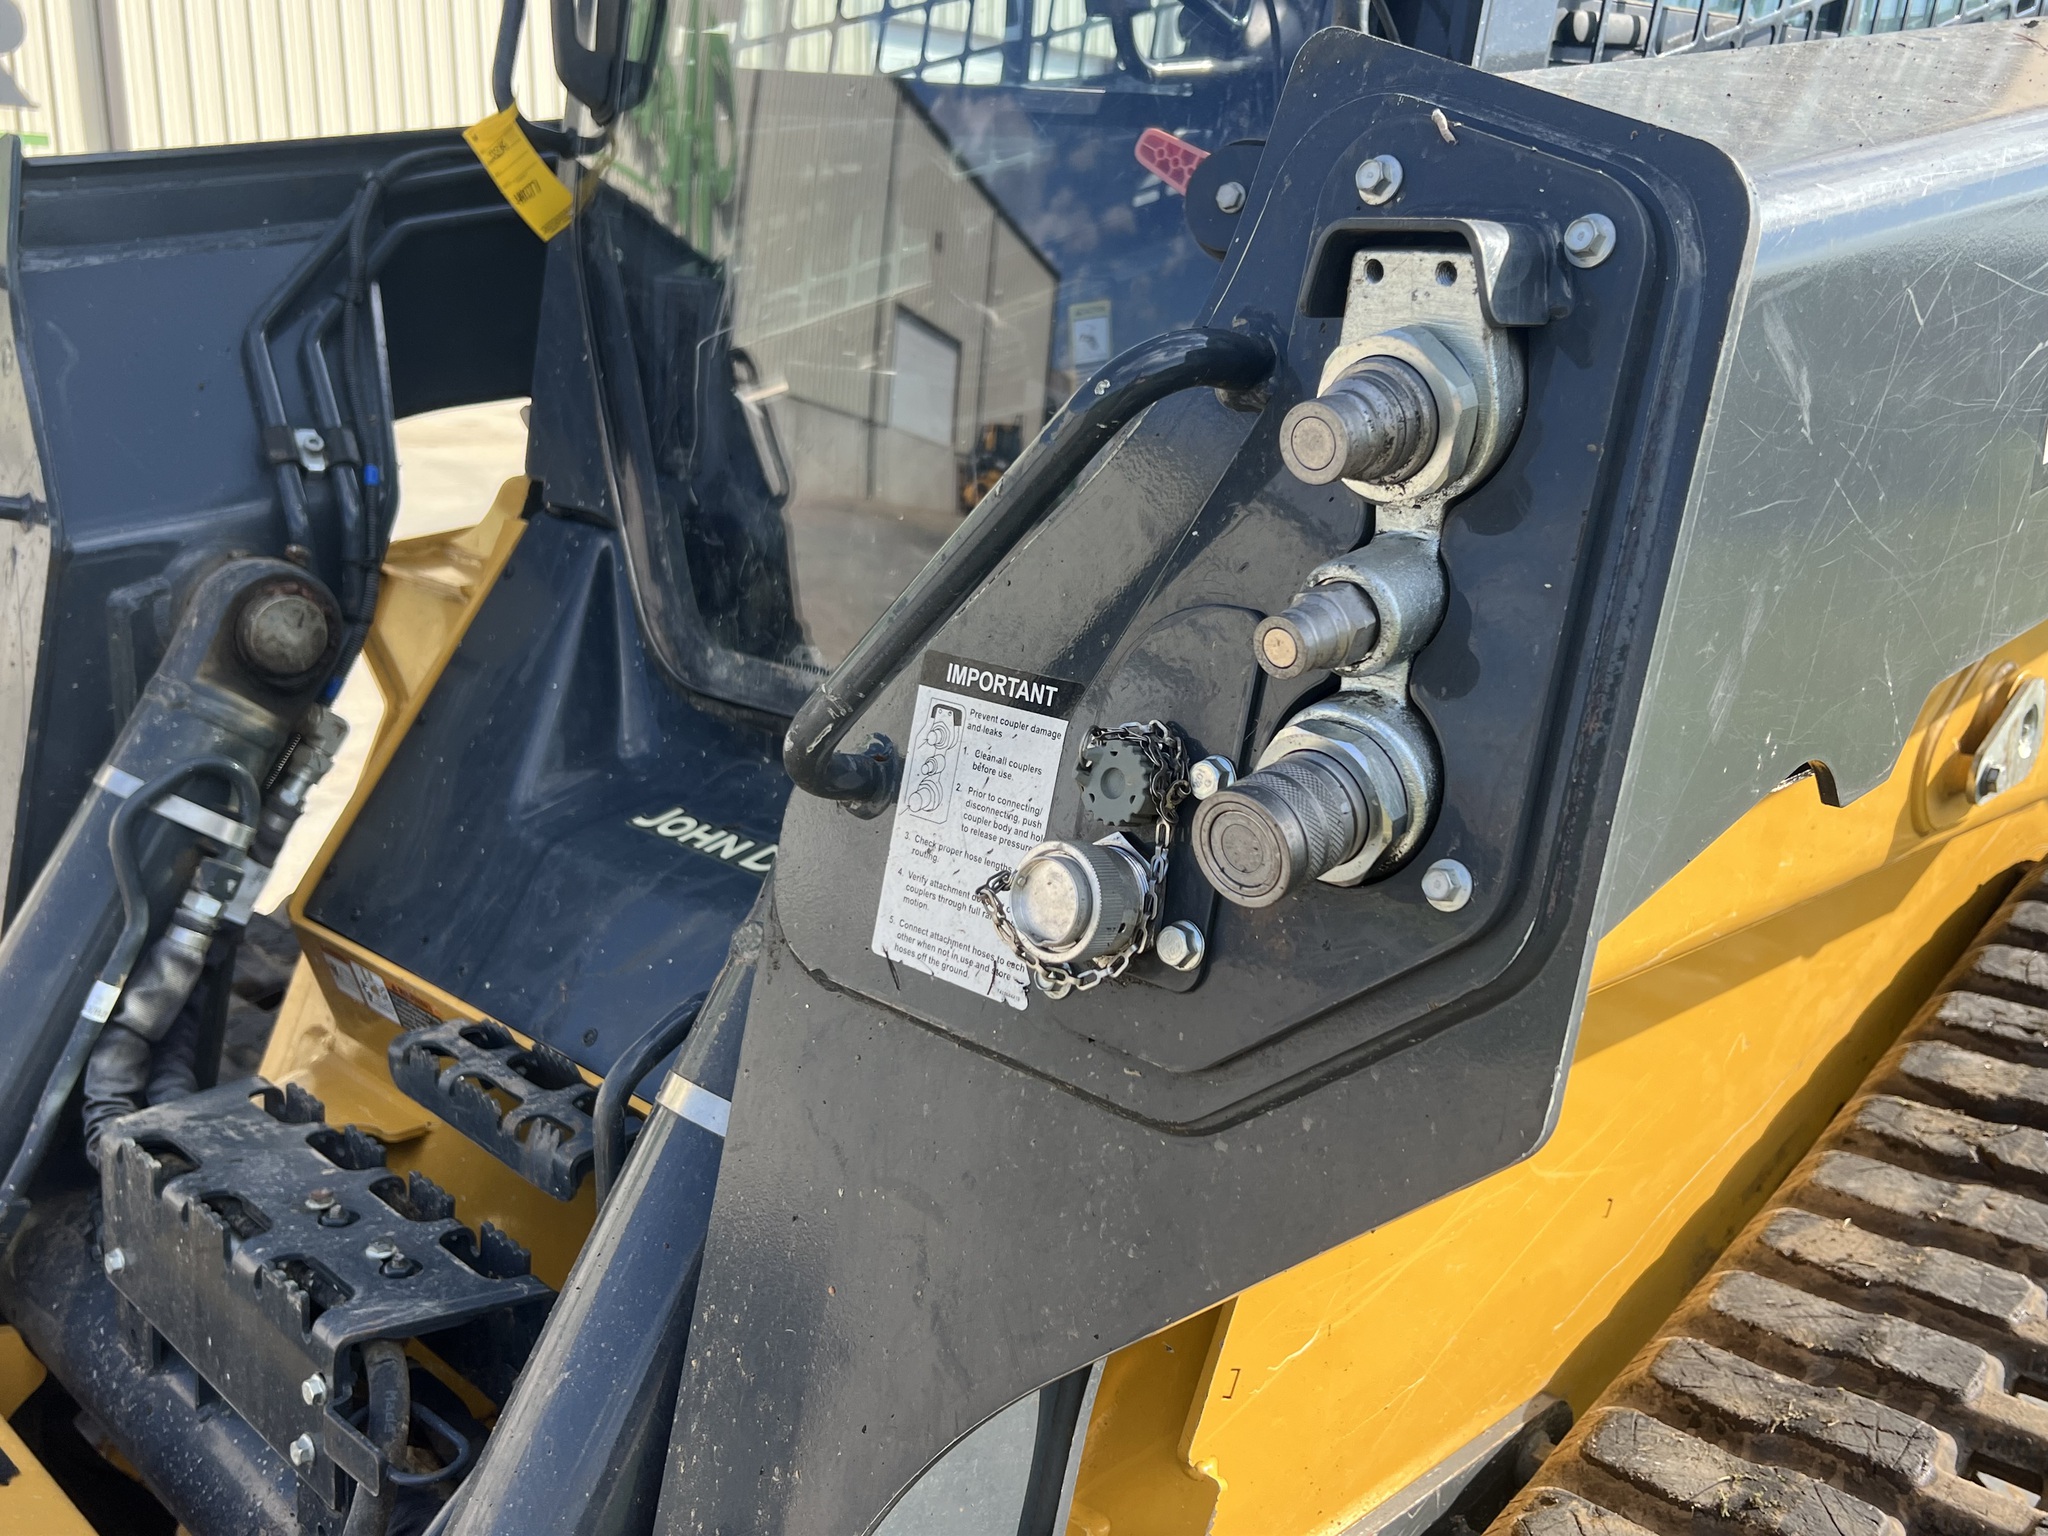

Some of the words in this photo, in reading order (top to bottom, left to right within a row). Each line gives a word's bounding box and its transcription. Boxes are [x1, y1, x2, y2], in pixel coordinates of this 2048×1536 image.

[946, 662, 1059, 707] IMPORTANT
[967, 722, 981, 732] and
[982, 726, 1003, 738] leaks
[970, 708, 999, 724] Prevent
[1000, 717, 1029, 731] coupler
[1030, 724, 1062, 740] damage
[963, 746, 969, 756] 1.
[974, 749, 996, 762] Clean
[997, 756, 1007, 766] all
[1009, 760, 1042, 775] couplers
[972, 762, 996, 776] before
[998, 770, 1014, 781] use.
[968, 786, 987, 800] Prior
[988, 793, 996, 802] to
[997, 797, 1043, 817] connecting/
[904, 832, 911, 840] 3.
[961, 824, 969, 833] to
[970, 827, 998, 841] release
[963, 812, 992, 826] coupler
[993, 820, 1012, 835] body
[1014, 827, 1029, 839] and
[1030, 831, 1044, 842] hol
[1022, 818, 1042, 829] push
[632, 807, 755, 860] JOHN
[738, 844, 779, 872] D
[915, 834, 936, 848] Check
[938, 844, 963, 858] proper
[964, 849, 982, 863] hose
[898, 868, 904, 877] 4.
[908, 870, 928, 886] Verify
[929, 878, 970, 900] attachment
[903, 896, 929, 911] motion.
[906, 884, 936, 901] couplers
[938, 894, 967, 912] through
[968, 904, 981, 916] full
[889, 916, 895, 924] 5.
[897, 932, 916, 944] other
[917, 940, 936, 952] when
[938, 948, 950, 958] not
[951, 949, 958, 961] in
[960, 956, 974, 967] use
[975, 961, 990, 973] and
[899, 919, 929, 936] Connect
[930, 931, 971, 952] attachment
[972, 946, 995, 962] hoses
[997, 955, 1005, 965] to
[1007, 960, 1026, 973] each
[894, 943, 916, 958] hoses
[916, 952, 928, 961] off
[928, 956, 940, 967] the
[941, 963, 970, 979] ground.
[384, 1390, 398, 1433] Made
